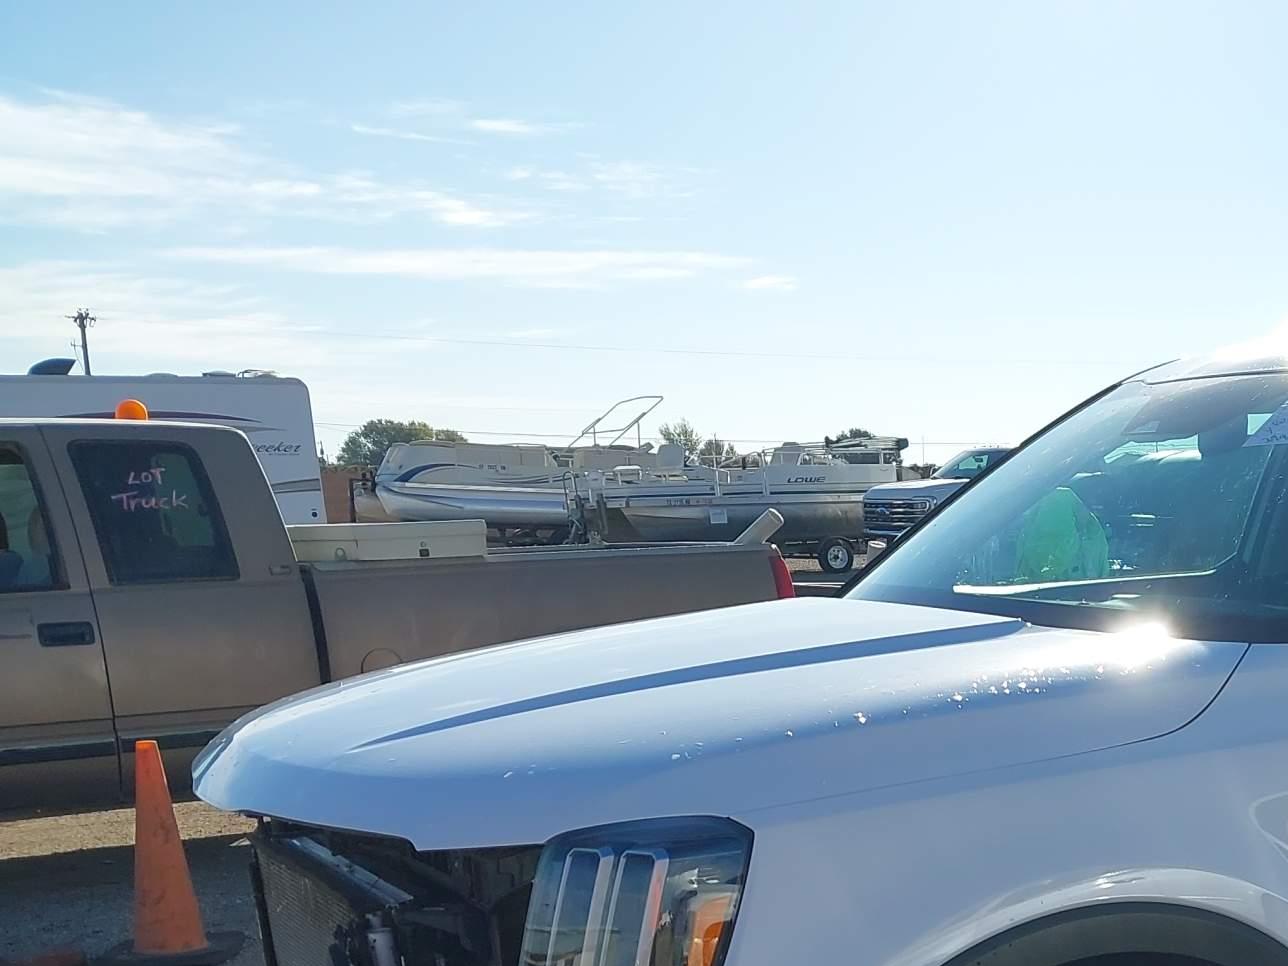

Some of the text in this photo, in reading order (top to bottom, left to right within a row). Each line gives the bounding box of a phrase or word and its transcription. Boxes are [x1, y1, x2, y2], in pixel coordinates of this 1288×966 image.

[252, 441, 302, 453] eeker
[127, 467, 166, 485] LOT
[787, 476, 826, 484] LOWE
[110, 488, 189, 512] Truck
